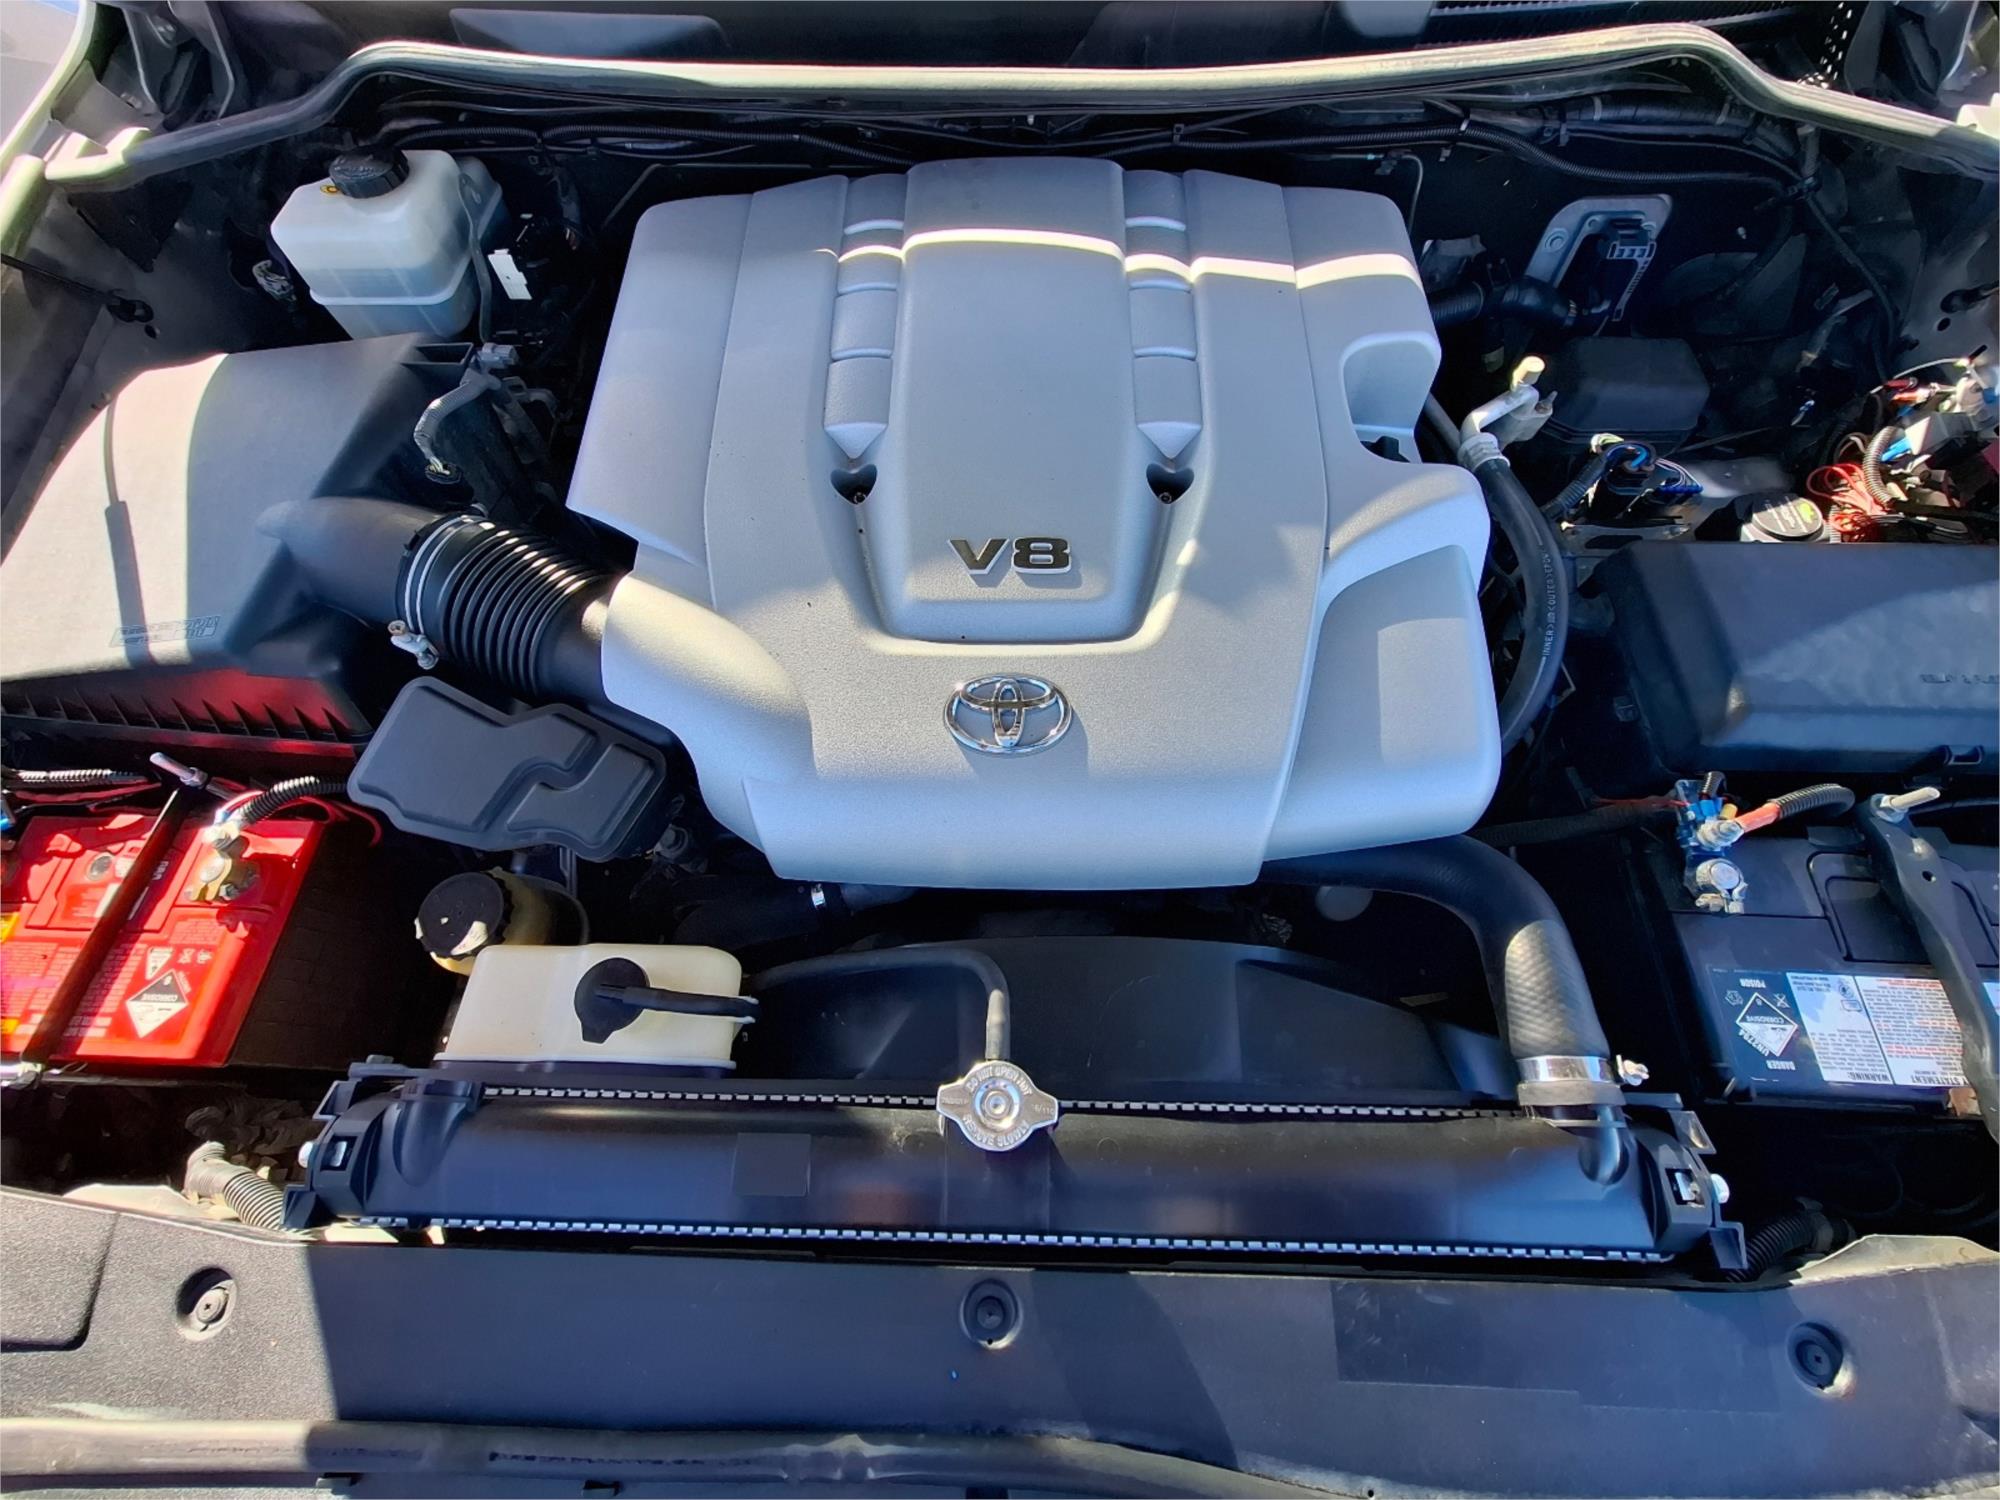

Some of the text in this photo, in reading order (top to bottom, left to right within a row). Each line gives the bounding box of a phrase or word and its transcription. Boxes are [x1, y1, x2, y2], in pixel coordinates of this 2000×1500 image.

[947, 537, 1071, 574] V8
[1740, 978, 1766, 989] POISON
[1745, 1014, 1785, 1025] CORROSIVE
[1766, 1060, 1796, 1071] DANGER
[967, 1066, 1033, 1095] DO NOT OPEN HOT
[1910, 1075, 1960, 1086] STATEMENT
[963, 1114, 1030, 1147] REMOVE SLOWLY
